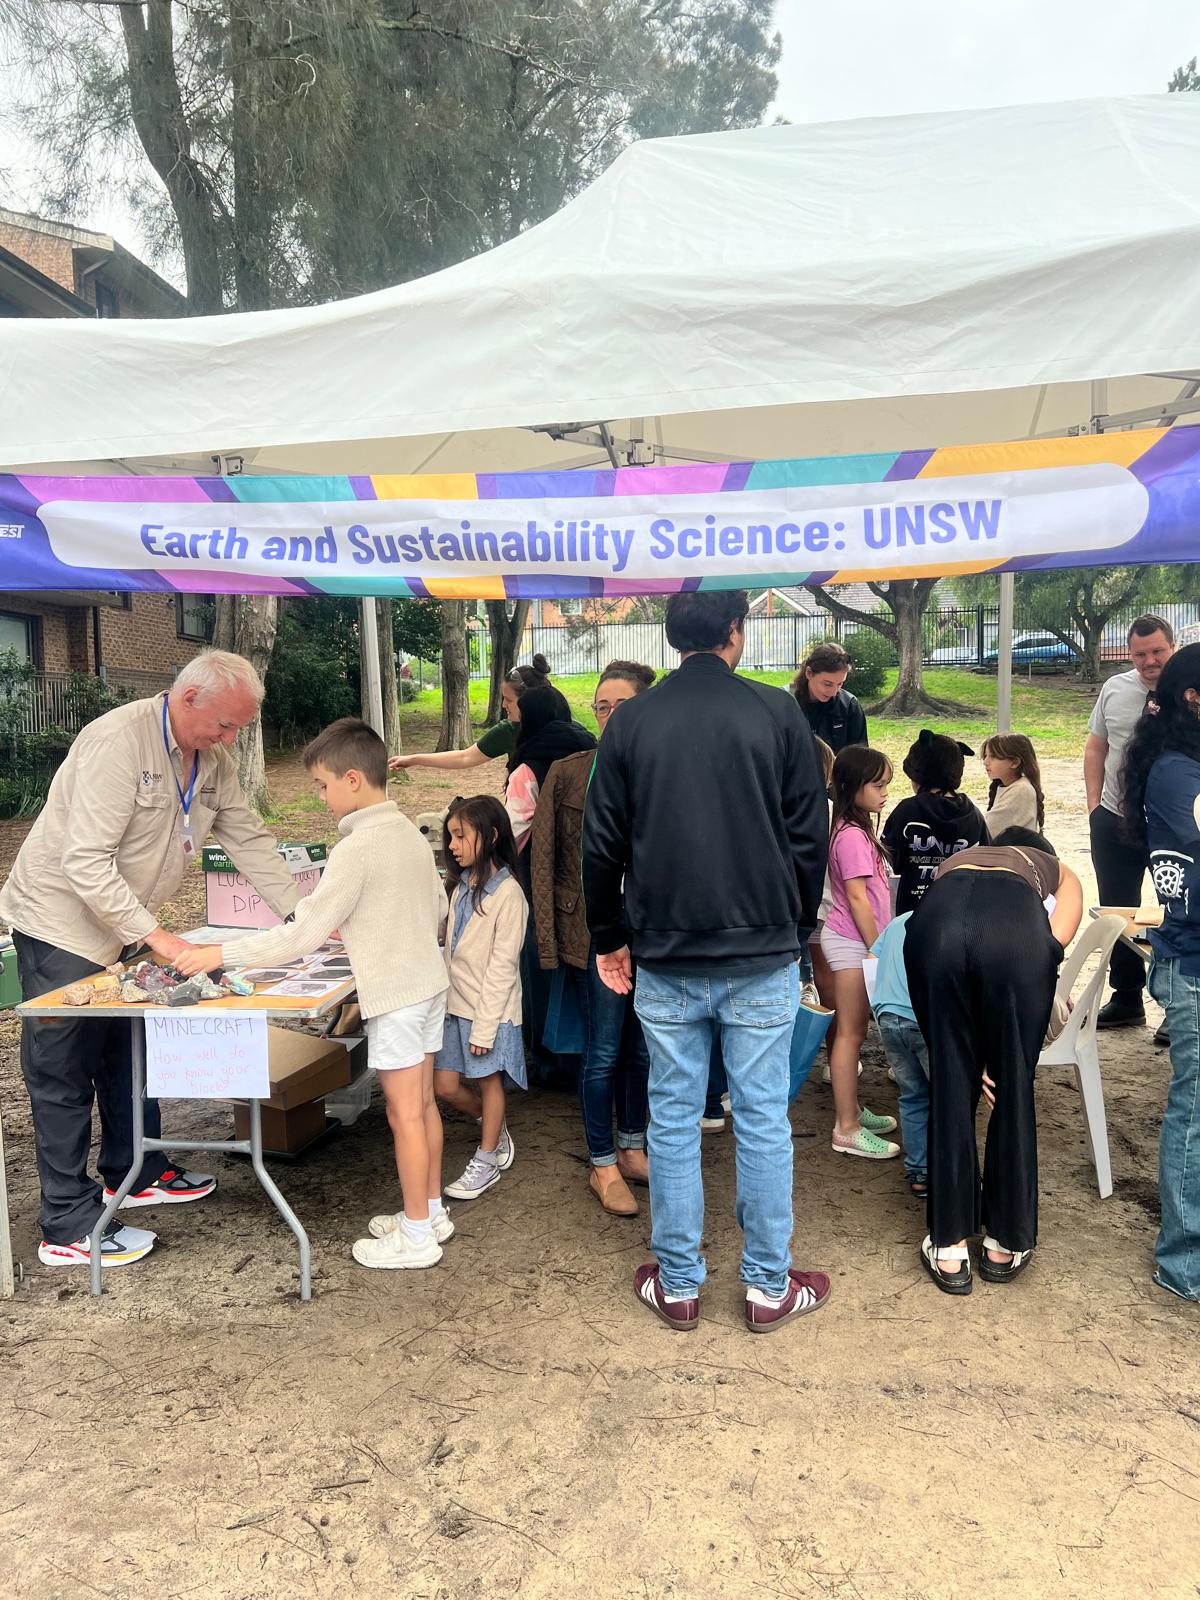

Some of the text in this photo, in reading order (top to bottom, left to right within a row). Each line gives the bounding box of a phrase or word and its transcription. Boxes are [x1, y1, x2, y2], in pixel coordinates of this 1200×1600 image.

[0, 524, 25, 539] EST
[140, 499, 1002, 572] Earth and Sustainability Science: UNSW
[208, 853, 228, 861] winc
[213, 860, 235, 868] earth
[232, 894, 262, 913] DIP
[153, 1016, 254, 1038] MINECRAFT
[152, 1047, 183, 1065] How
[156, 1070, 177, 1090] you
